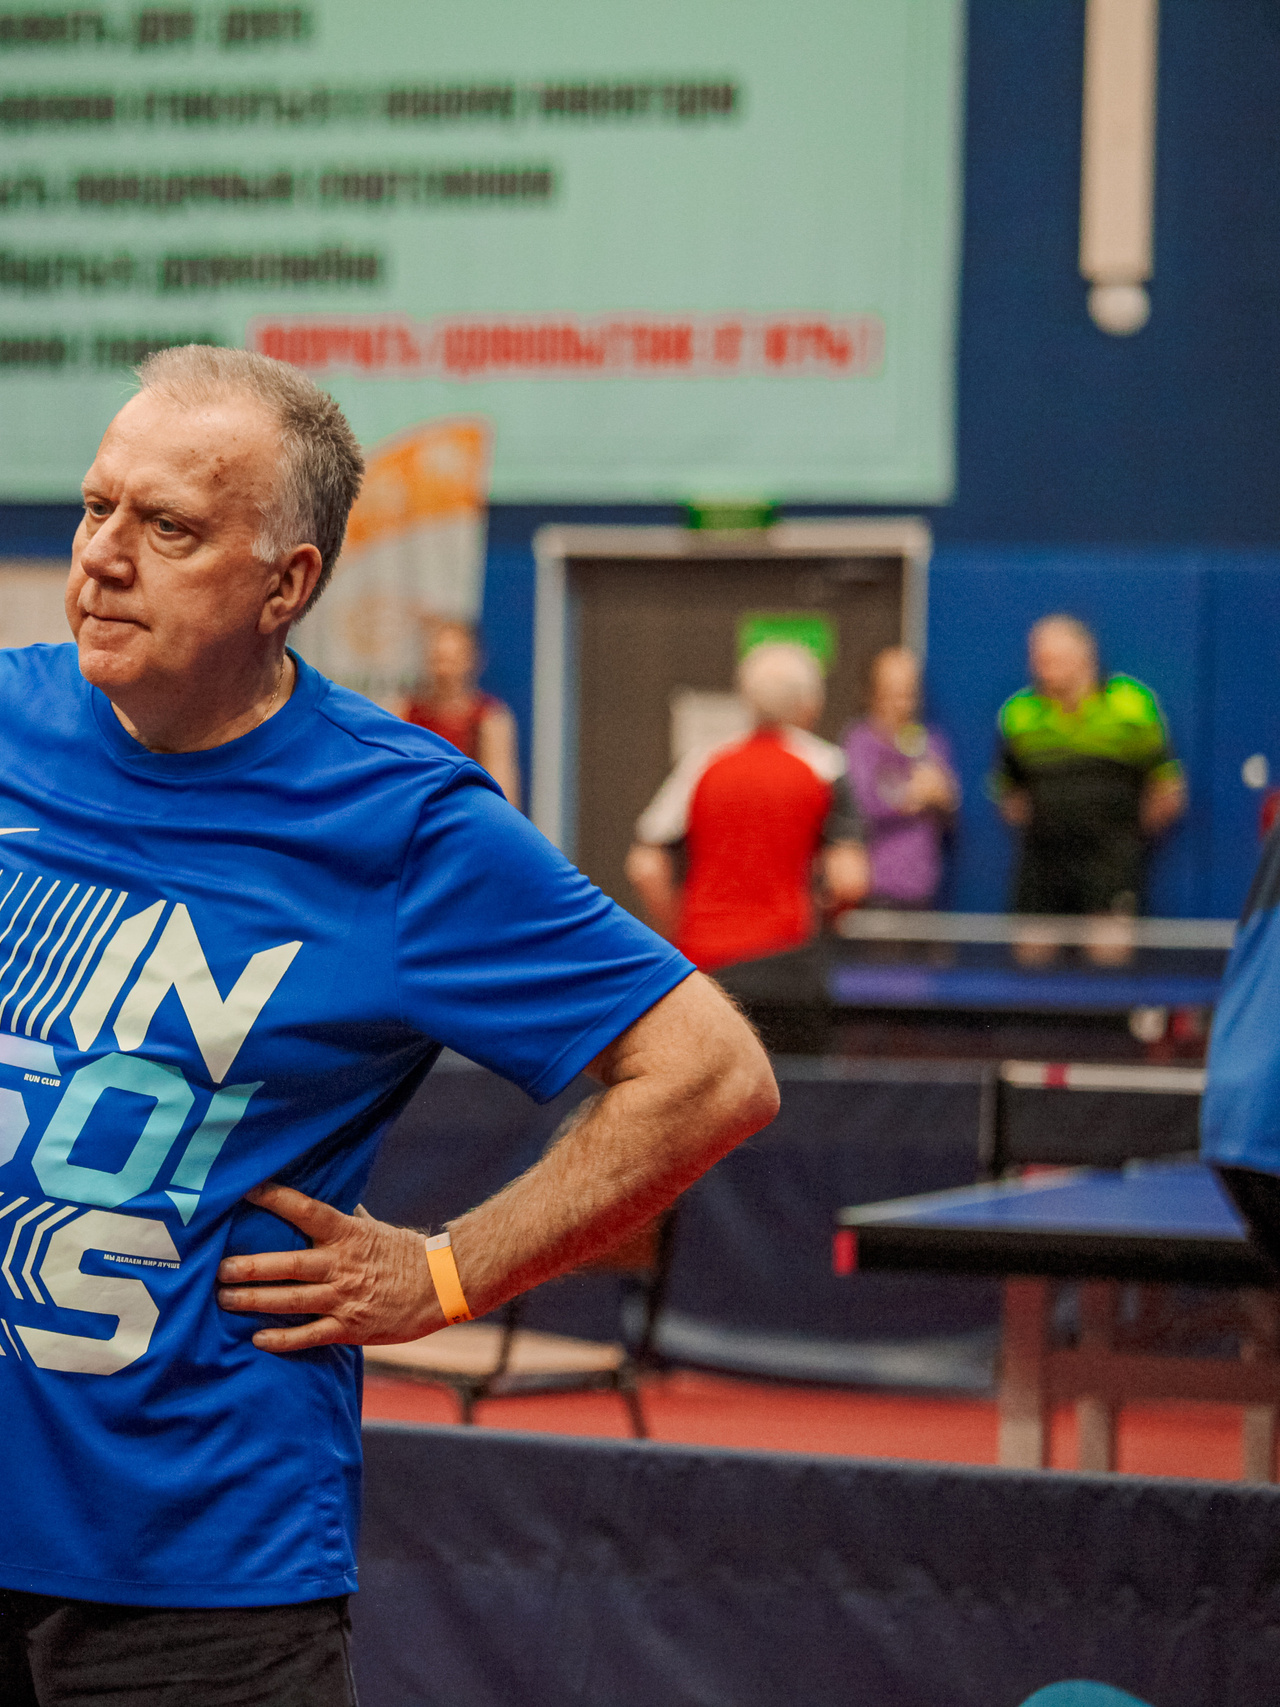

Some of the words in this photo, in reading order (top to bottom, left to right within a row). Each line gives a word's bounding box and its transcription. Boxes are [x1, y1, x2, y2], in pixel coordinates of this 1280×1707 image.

[69, 899, 304, 1085] IN
[23, 1073, 41, 1084] RUN
[40, 1077, 61, 1087] CLUB
[14, 1209, 181, 1376] S
[103, 1253, 116, 1262] МЫ
[115, 1255, 142, 1265] ДЕЛАЕМ
[142, 1259, 157, 1267] МИР
[157, 1261, 180, 1270] ЛУЧШЕ
